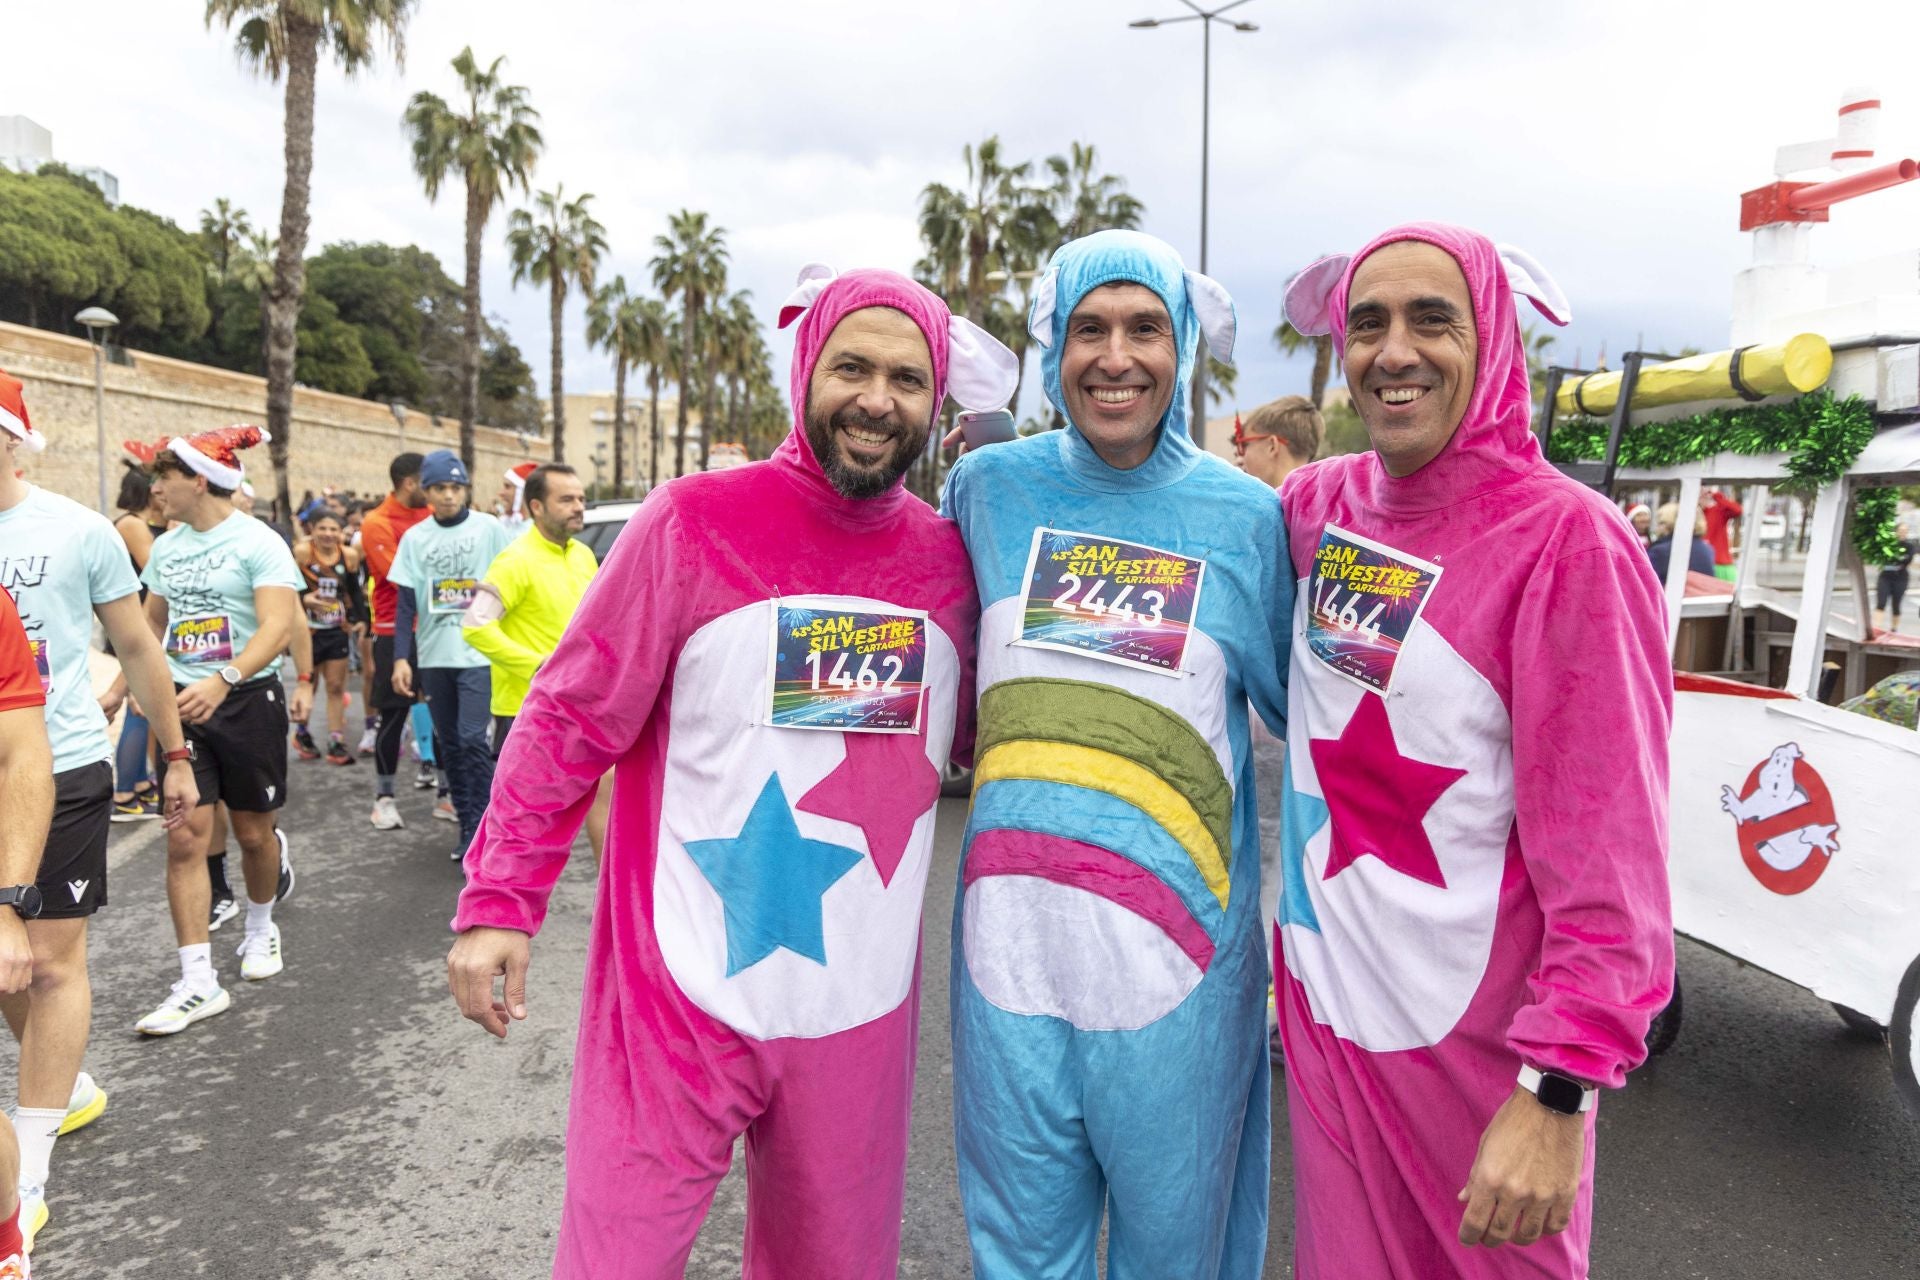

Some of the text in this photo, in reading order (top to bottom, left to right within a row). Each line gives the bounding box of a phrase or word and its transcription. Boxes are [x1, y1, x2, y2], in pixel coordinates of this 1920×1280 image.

[1071, 545, 1119, 560] SAN
[1323, 544, 1360, 565] SAN
[1066, 560, 1188, 577] SILVESTRE
[1320, 561, 1421, 588] SILVESTRE
[1115, 576, 1183, 585] CARTAGENA
[1348, 582, 1412, 598] CARTAGENA
[1052, 573, 1165, 627] 2443
[1314, 576, 1387, 644] 1464
[811, 616, 854, 636] SAN
[176, 632, 219, 652] 1960
[808, 620, 916, 654] SILVESTRE
[857, 637, 915, 654] CARTAGENA
[805, 652, 903, 693] 1462
